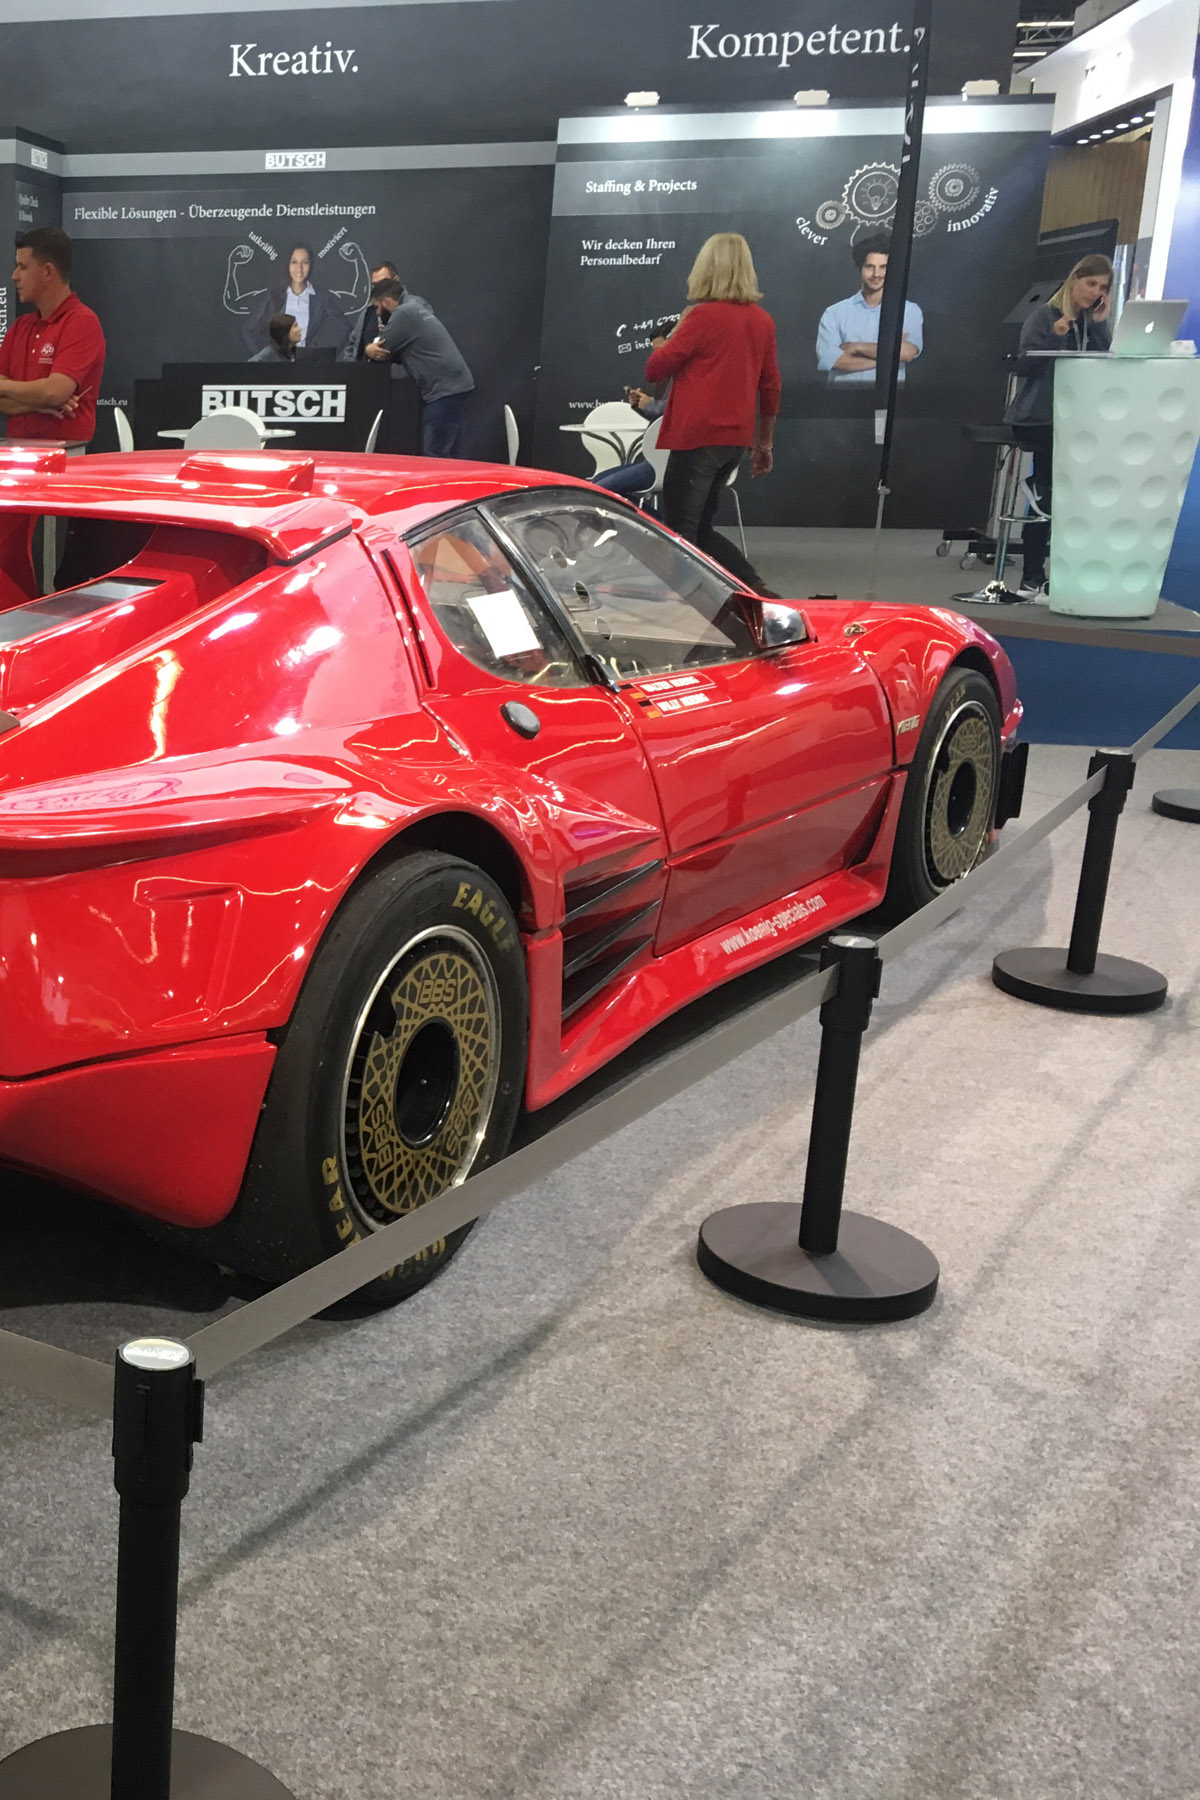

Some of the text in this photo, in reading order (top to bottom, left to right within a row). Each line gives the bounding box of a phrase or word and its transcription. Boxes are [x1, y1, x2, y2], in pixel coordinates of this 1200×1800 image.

[229, 41, 359, 77] Kreativ.
[686, 22, 911, 68] Kompetent.
[265, 152, 326, 169] BUTSCH
[585, 179, 698, 196] Staffing & Projects
[74, 206, 119, 220] Flexible
[121, 206, 177, 223] Lösungen
[188, 203, 273, 221] Überzeugende
[276, 202, 376, 219] Dienstleistungen
[946, 186, 999, 232] innovativ
[317, 225, 348, 259] motiviert
[581, 238, 676, 251] Wir decken Ihren
[795, 216, 829, 246] clever
[580, 253, 662, 267] Personalbedarf
[201, 390, 346, 417] BUTSCH
[451, 881, 516, 952] EAGLE
[719, 894, 827, 956] www.koenig-specials.com
[419, 978, 457, 1004] BBS
